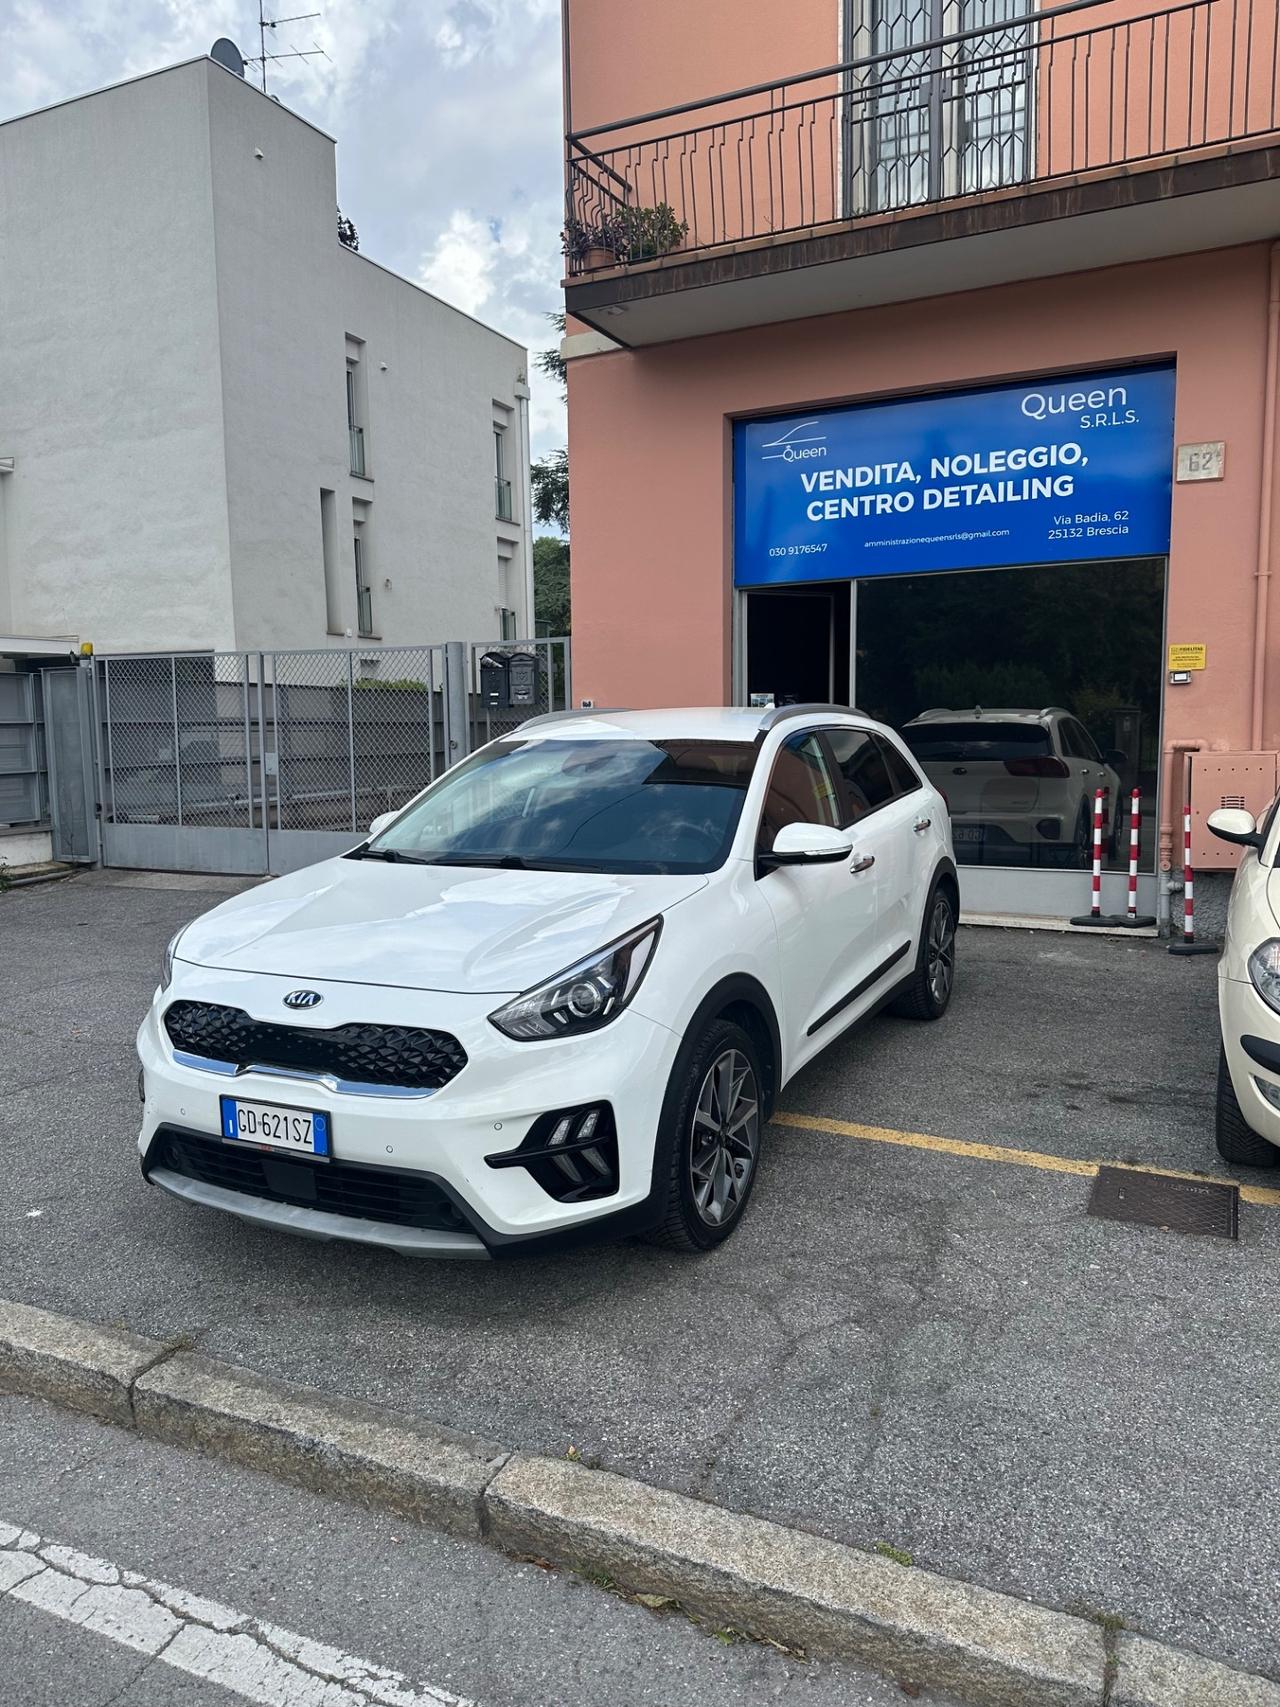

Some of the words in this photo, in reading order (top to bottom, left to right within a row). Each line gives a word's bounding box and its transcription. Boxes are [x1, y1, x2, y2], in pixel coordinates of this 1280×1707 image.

[1021, 386, 1127, 420] Queen
[1080, 410, 1139, 429] S.R.L.S.
[783, 446, 827, 462] Queen
[801, 461, 921, 493] VENDITA,
[931, 442, 1088, 478] NOLEGGIO,
[807, 491, 915, 521] CENTRO
[923, 475, 1074, 510] DETAILING
[1054, 516, 1072, 525] Via
[1114, 510, 1129, 520] 62
[864, 528, 1010, 547] amministrazionequeensrls@gmail.com
[1048, 527, 1083, 539] 25132
[1087, 525, 1129, 536] Brescia
[769, 547, 786, 556] 030
[788, 543, 828, 555] 9176547
[286, 992, 315, 1005] KIA
